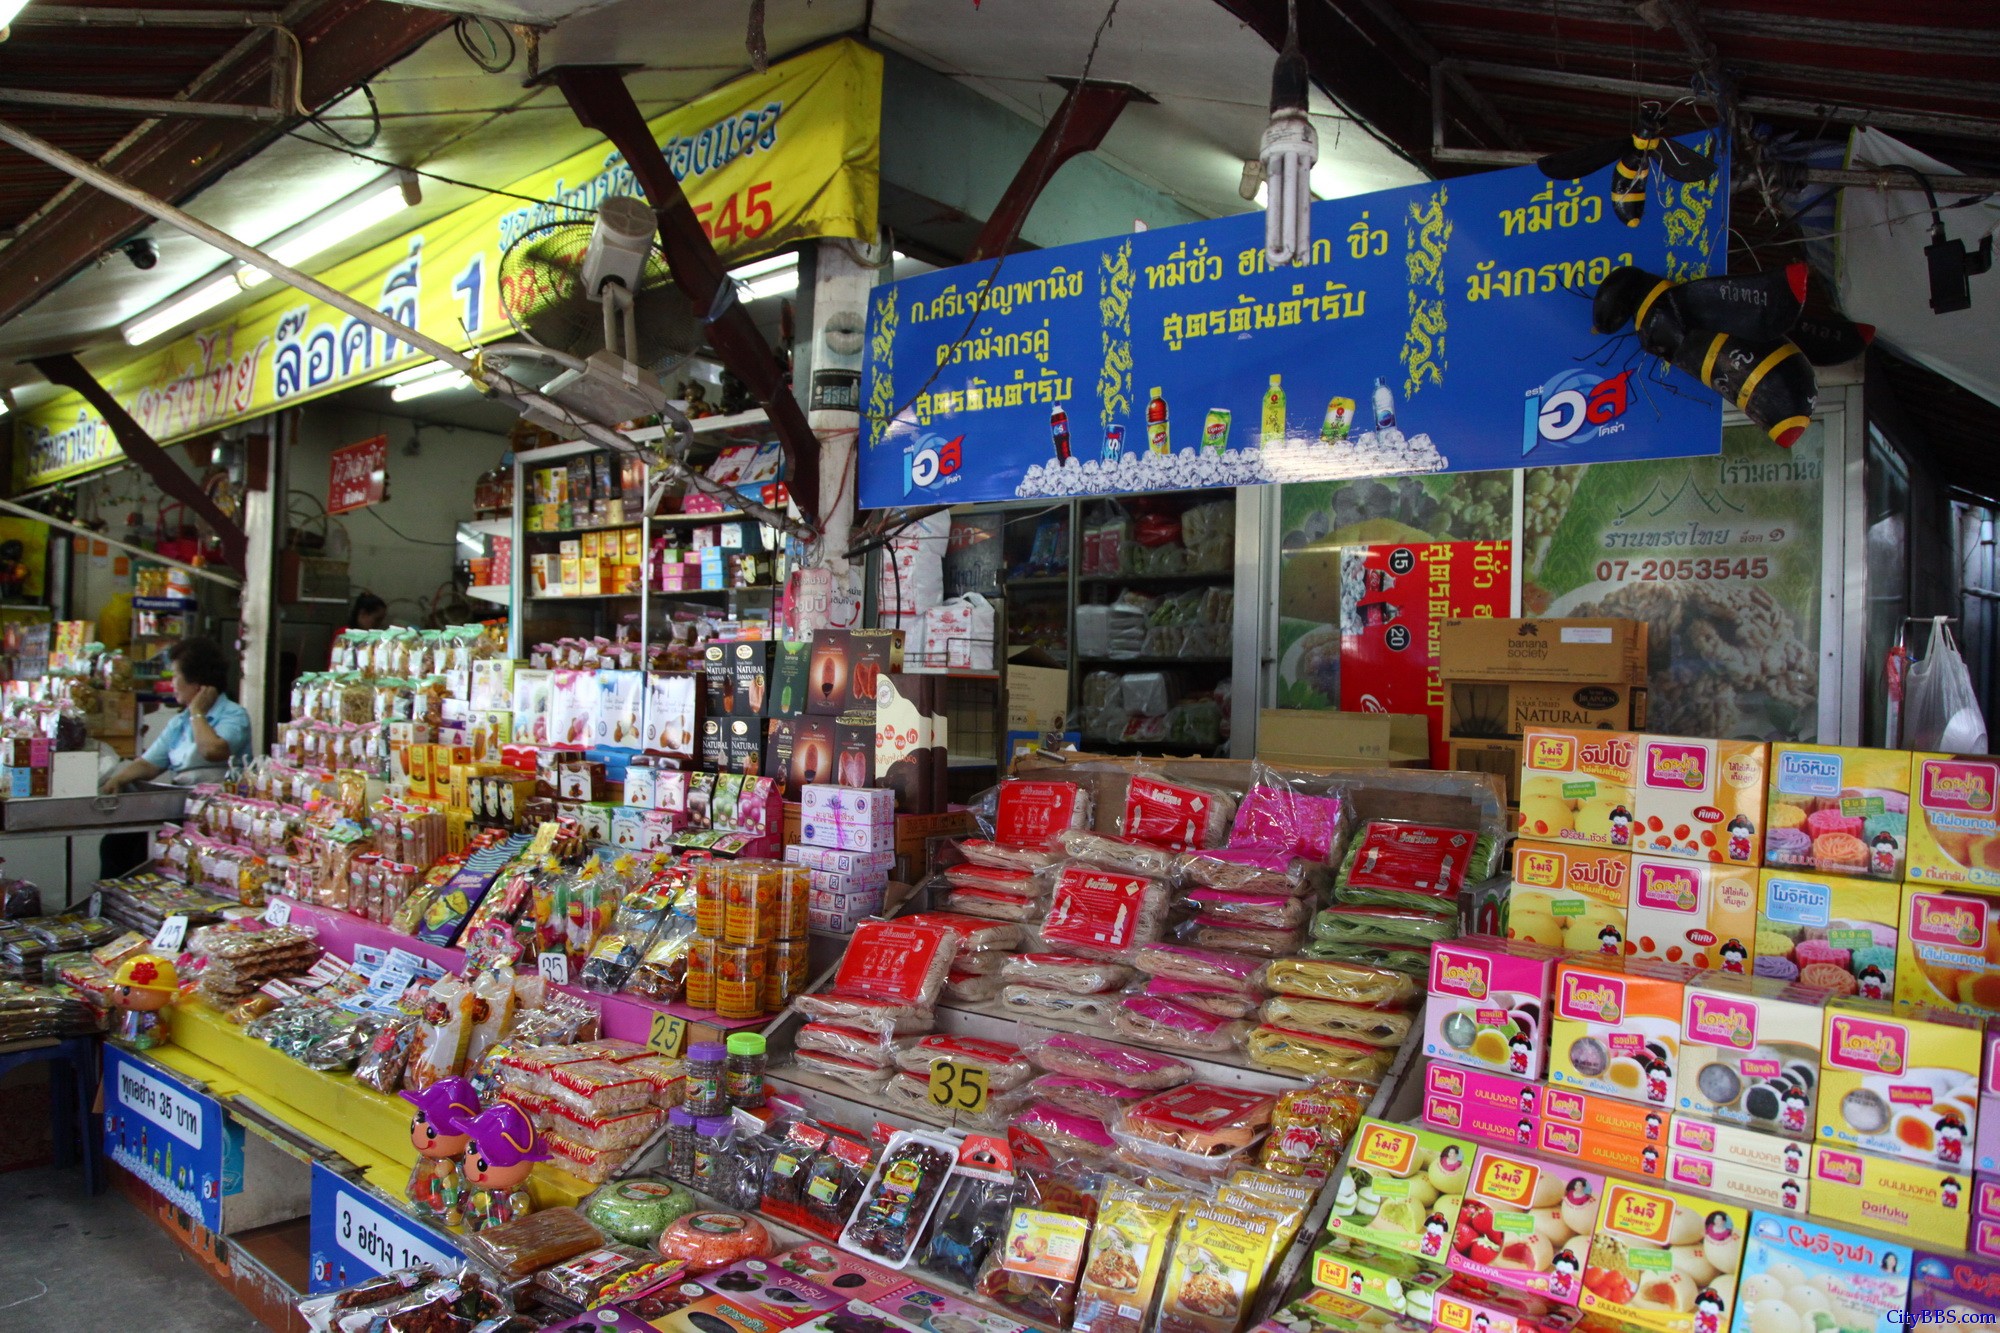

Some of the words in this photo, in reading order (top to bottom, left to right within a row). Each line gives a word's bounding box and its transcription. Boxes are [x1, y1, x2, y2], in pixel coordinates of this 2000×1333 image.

[1499, 180, 1603, 237] หมี่ซั่ว
[1145, 239, 1223, 290] หมี่ซั่ว
[1347, 212, 1389, 260] ซิ่ว
[452, 258, 484, 334] 1
[911, 266, 1084, 325] ก.ศรีเจริญพานิช
[1163, 282, 1367, 352] สูตรต้นตำรับ
[936, 319, 1050, 366] ตรามังกรคู่
[916, 370, 1073, 428] สูตรต้นตำรับ
[1604, 519, 1730, 548] ร้านทรงไทย
[1394, 550, 1409, 568] 15
[1596, 556, 1769, 581] 07-2053545
[1390, 627, 1405, 647] 20
[1508, 638, 1549, 648] banana
[1507, 649, 1549, 660] society
[706, 666, 734, 675] NATURAL
[736, 664, 764, 674] NATURAL
[1514, 707, 1592, 725] NATURAL
[702, 740, 728, 750] NATURAL
[731, 740, 759, 750] NATURAL
[1579, 739, 1634, 768] จัมโบ้
[1785, 757, 1836, 776] โมจิหิมะ
[1698, 809, 1720, 820] พิเศษ
[1930, 812, 1996, 830] ไส้ฝอยทอง
[1569, 859, 1624, 887] จัมโบ้
[1772, 884, 1824, 906] โมจิหิมะ
[651, 1015, 679, 1050] 25
[932, 1061, 984, 1109] 35
[122, 1074, 156, 1110] ทุกอย่าง
[160, 1092, 172, 1119] 35
[176, 1105, 197, 1135] บาท
[1194, 1207, 1267, 1235] ผัดไทยประยุกต์
[1861, 1200, 1909, 1220] Daifuku
[343, 1210, 352, 1239] 3
[358, 1222, 394, 1268] อย่าง
